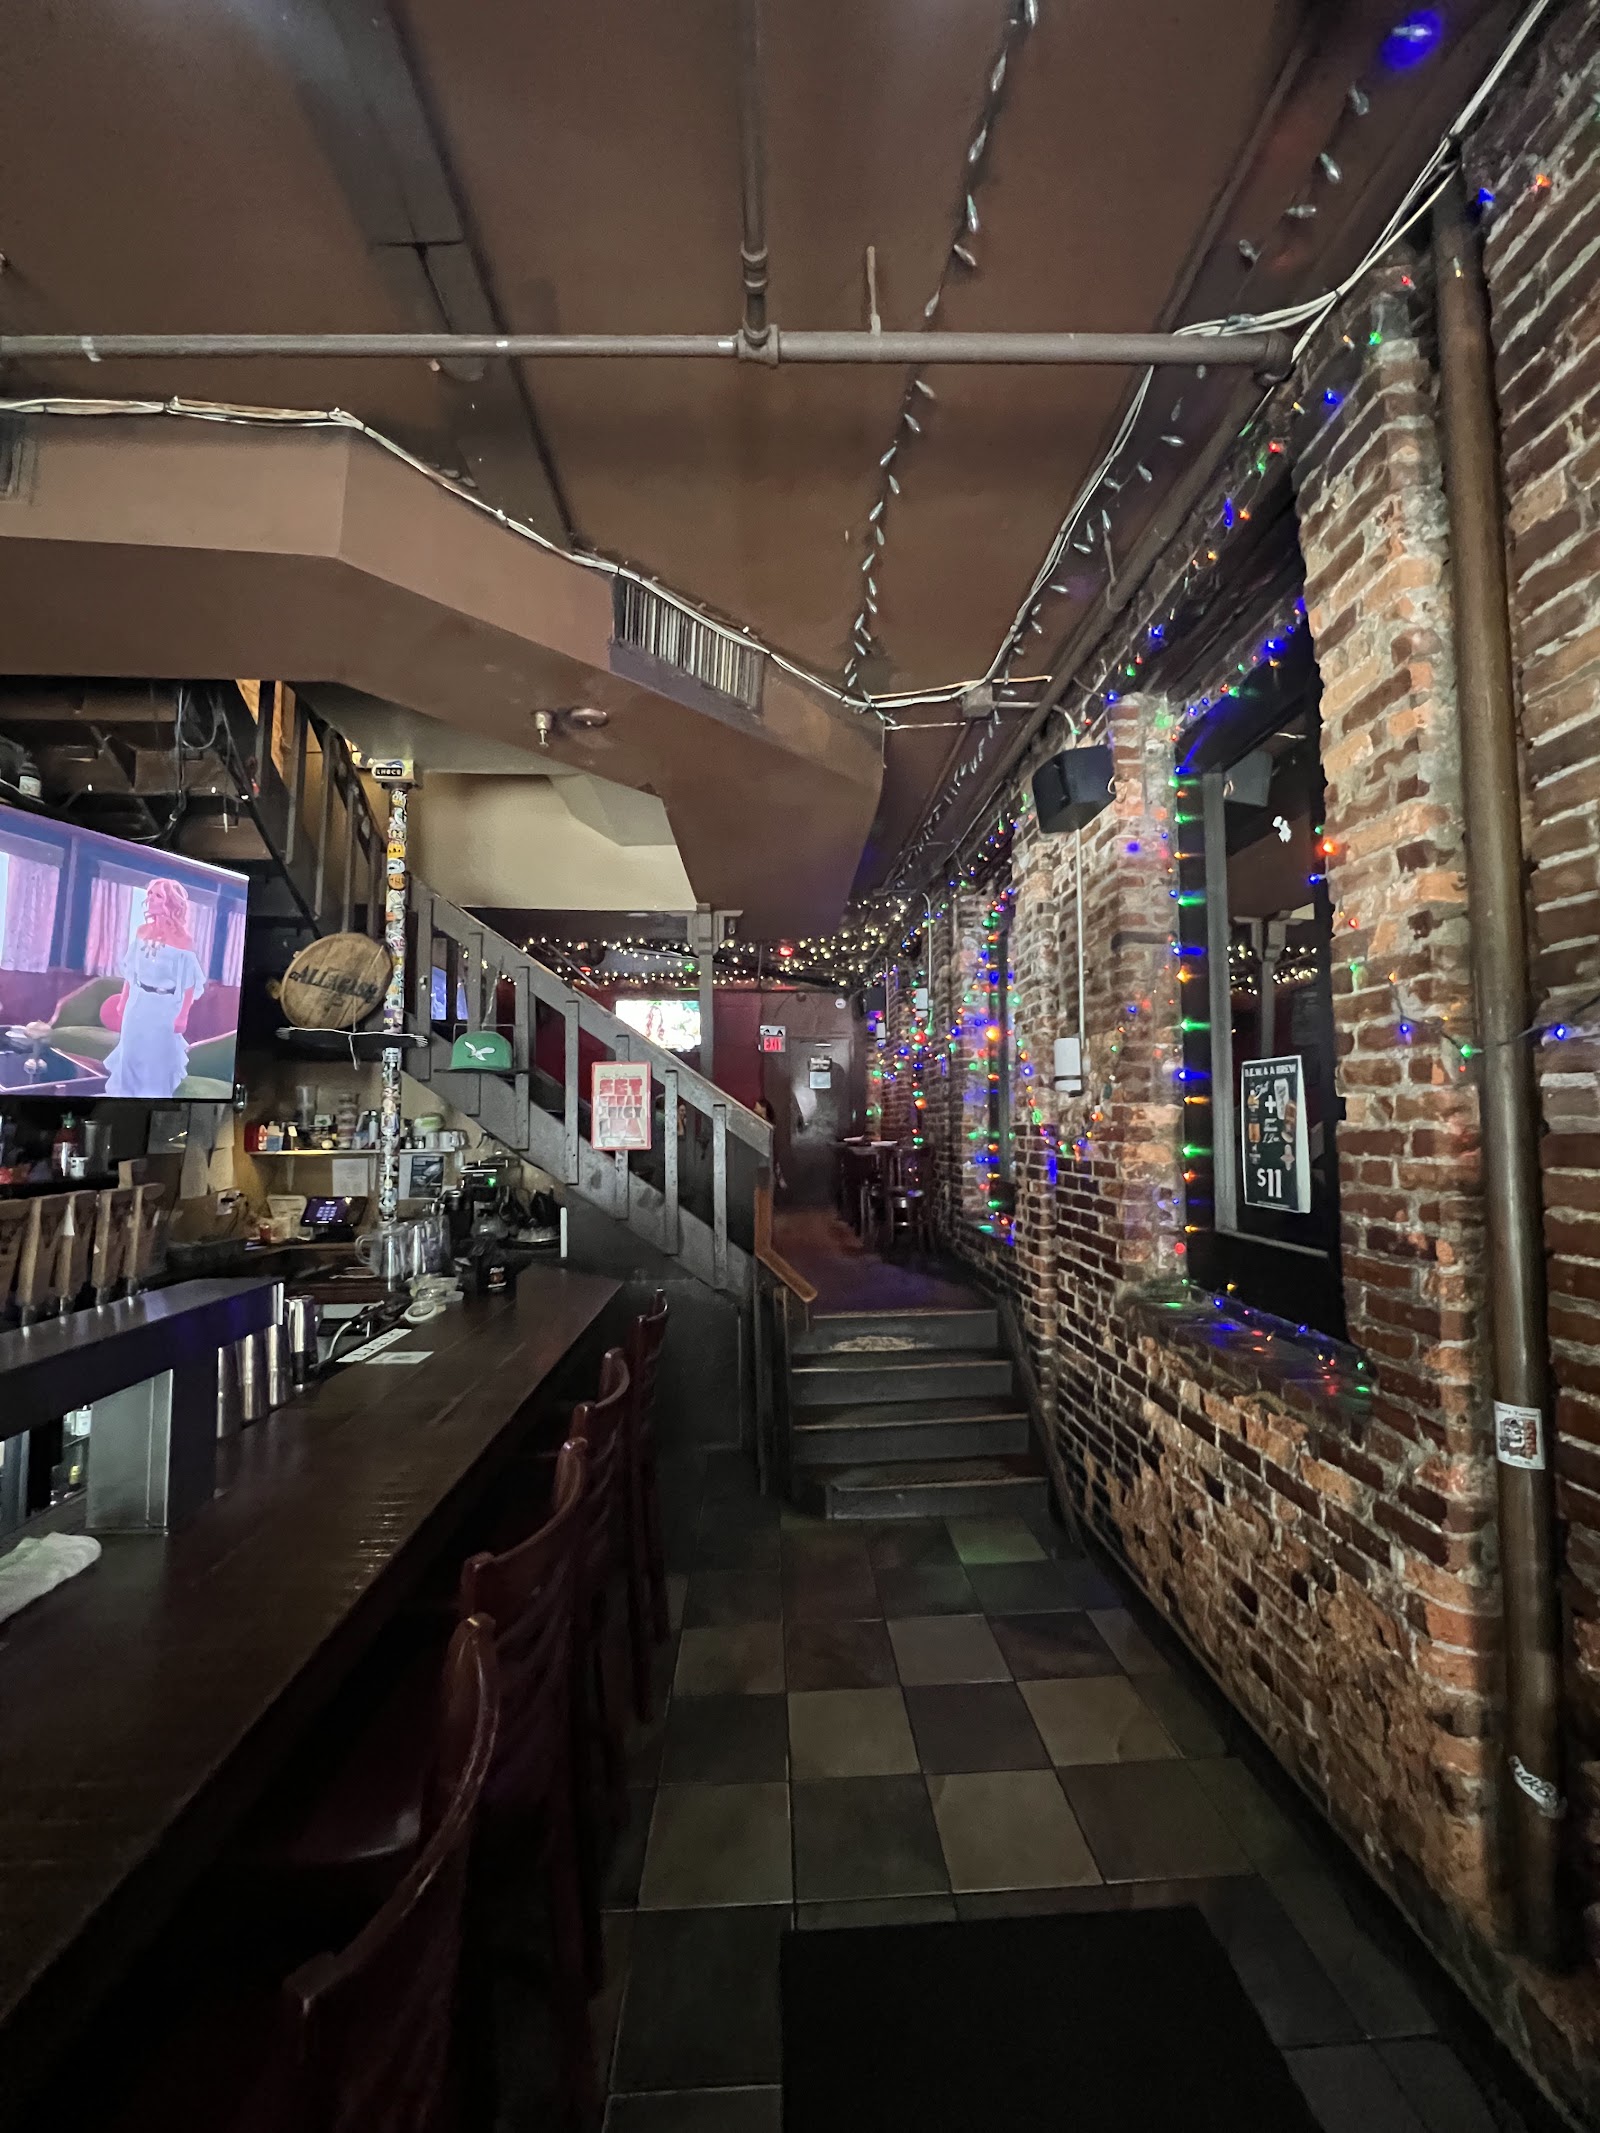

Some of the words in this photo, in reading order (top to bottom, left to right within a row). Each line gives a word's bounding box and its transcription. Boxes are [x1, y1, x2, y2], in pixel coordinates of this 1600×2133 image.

[764, 1037, 781, 1052] EXIT
[600, 1078, 643, 1096] SET
[1257, 1167, 1283, 1199] $11
